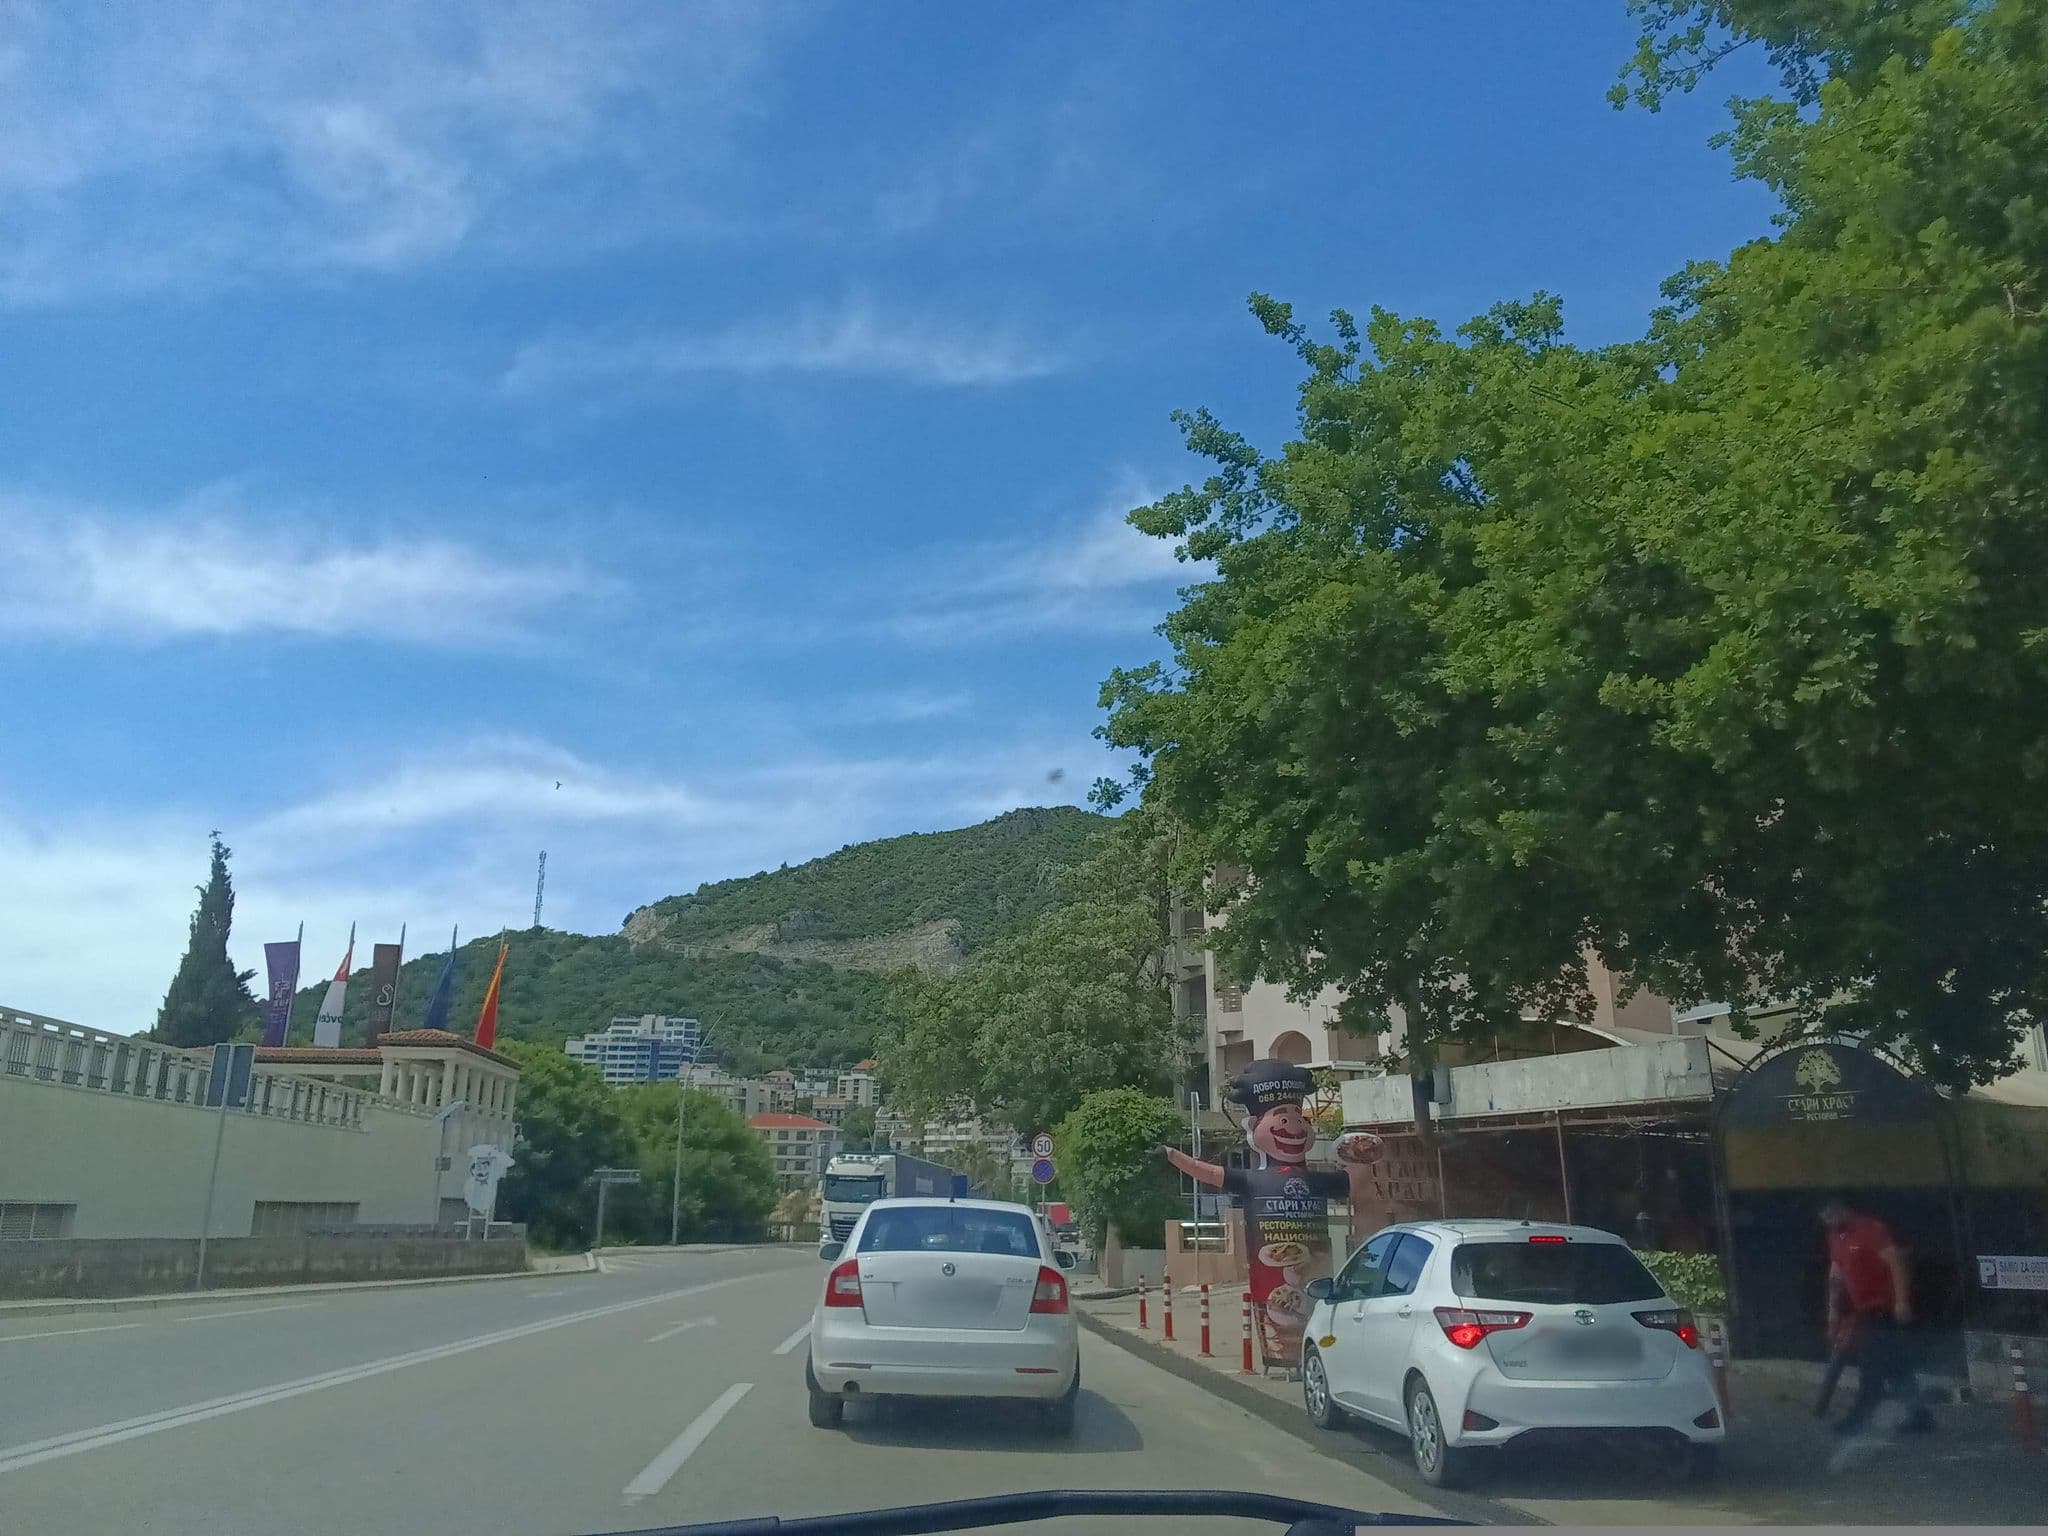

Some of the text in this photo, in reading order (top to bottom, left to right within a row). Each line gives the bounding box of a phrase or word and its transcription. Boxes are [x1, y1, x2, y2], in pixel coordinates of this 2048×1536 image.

[1253, 1080, 1281, 1095] ДОБРО
[1258, 1093, 1275, 1103] 068
[1037, 1140, 1051, 1153] 50
[1265, 1199, 1299, 1211] СТАРИ
